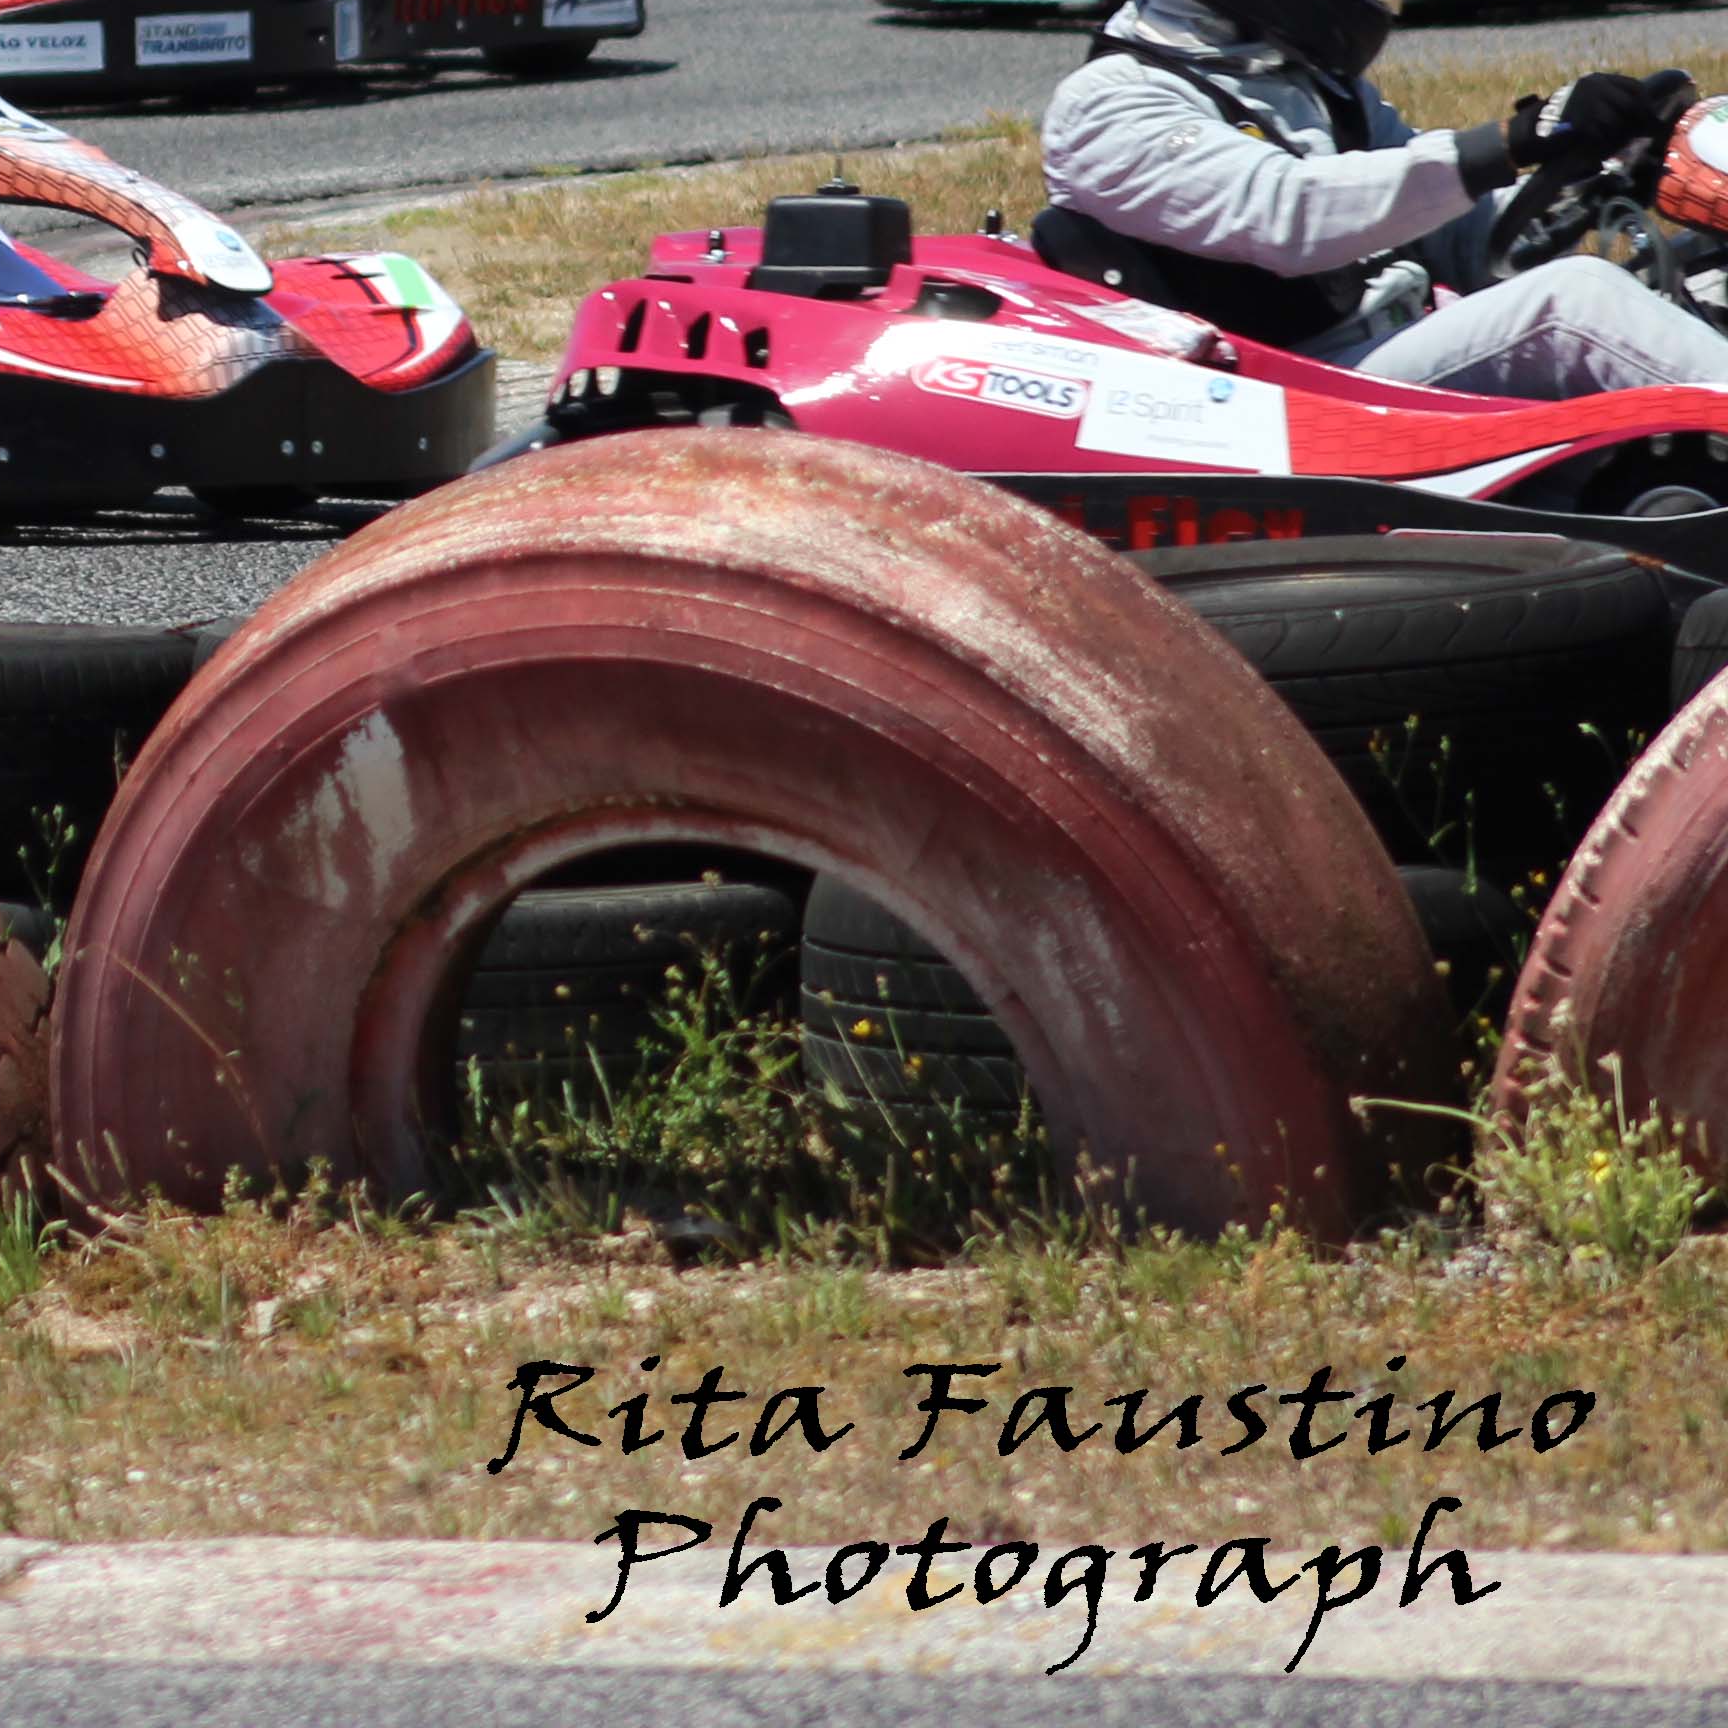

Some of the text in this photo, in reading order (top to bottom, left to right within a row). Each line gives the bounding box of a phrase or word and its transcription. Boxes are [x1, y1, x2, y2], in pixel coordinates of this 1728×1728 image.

[28, 35, 87, 50] VELOZ
[923, 359, 1077, 408] KS TOOLS
